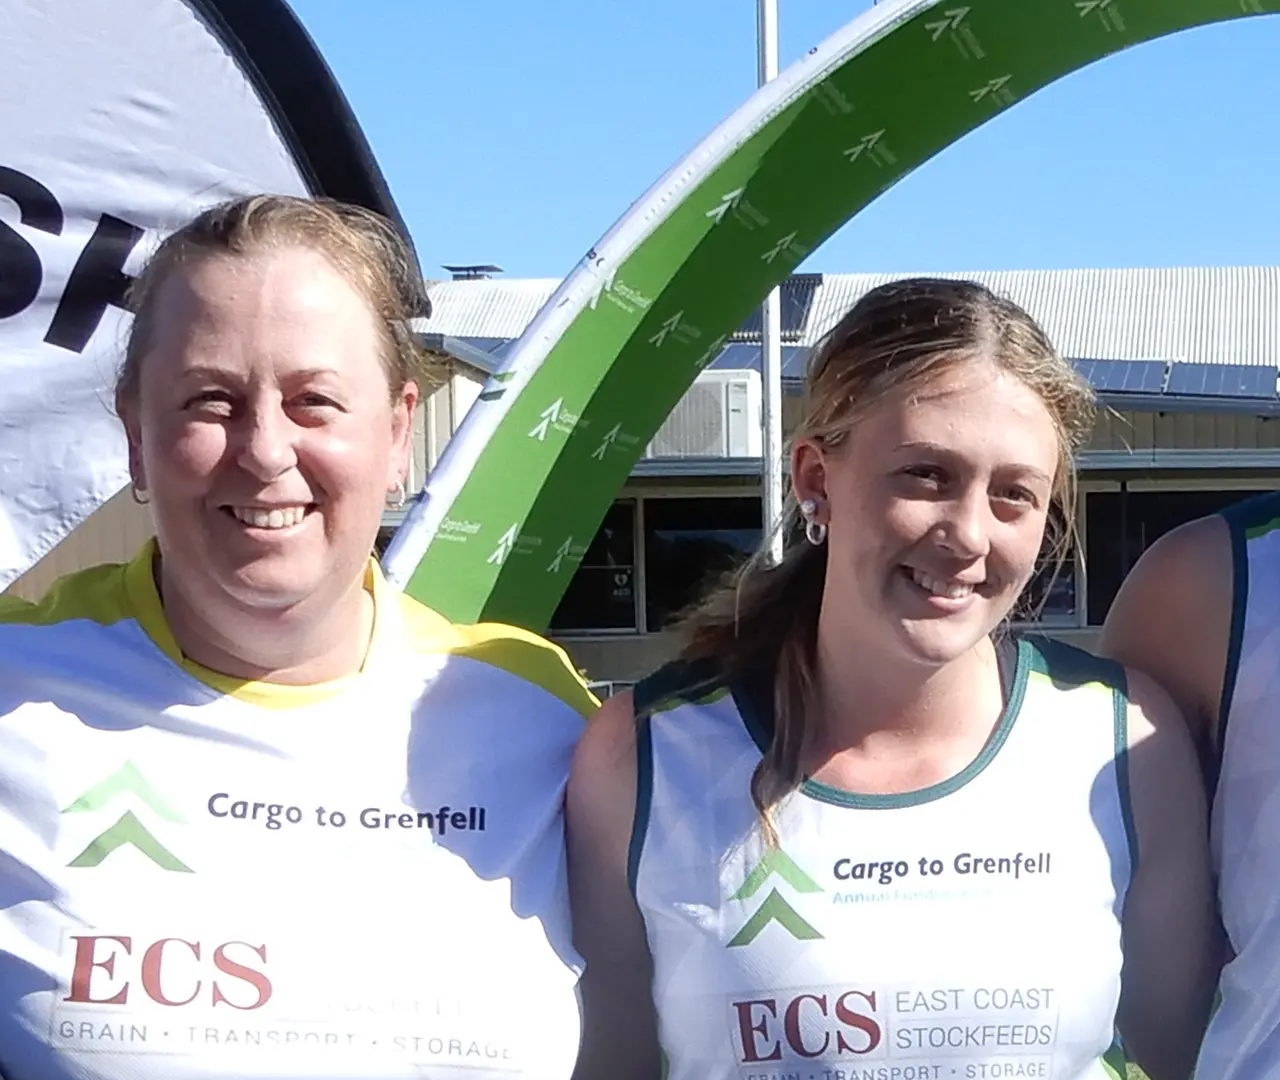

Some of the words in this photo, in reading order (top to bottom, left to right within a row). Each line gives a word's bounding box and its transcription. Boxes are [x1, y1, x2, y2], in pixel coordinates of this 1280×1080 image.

[207, 793, 302, 830] Cargo
[315, 806, 347, 828] to
[359, 806, 486, 835] Grenfell
[833, 857, 909, 884] Cargo
[919, 857, 943, 876] to
[953, 853, 1051, 880] Grenfell
[62, 935, 273, 1010] ECS
[895, 988, 964, 1013] EAST
[973, 987, 1054, 1010] COAST
[59, 1020, 148, 1042] GRAIN
[188, 1025, 358, 1046] TRANSPORT
[733, 990, 881, 1063] ECS
[896, 1024, 1052, 1049] STOCKFEEDS
[965, 1062, 1046, 1079] STORAGE
